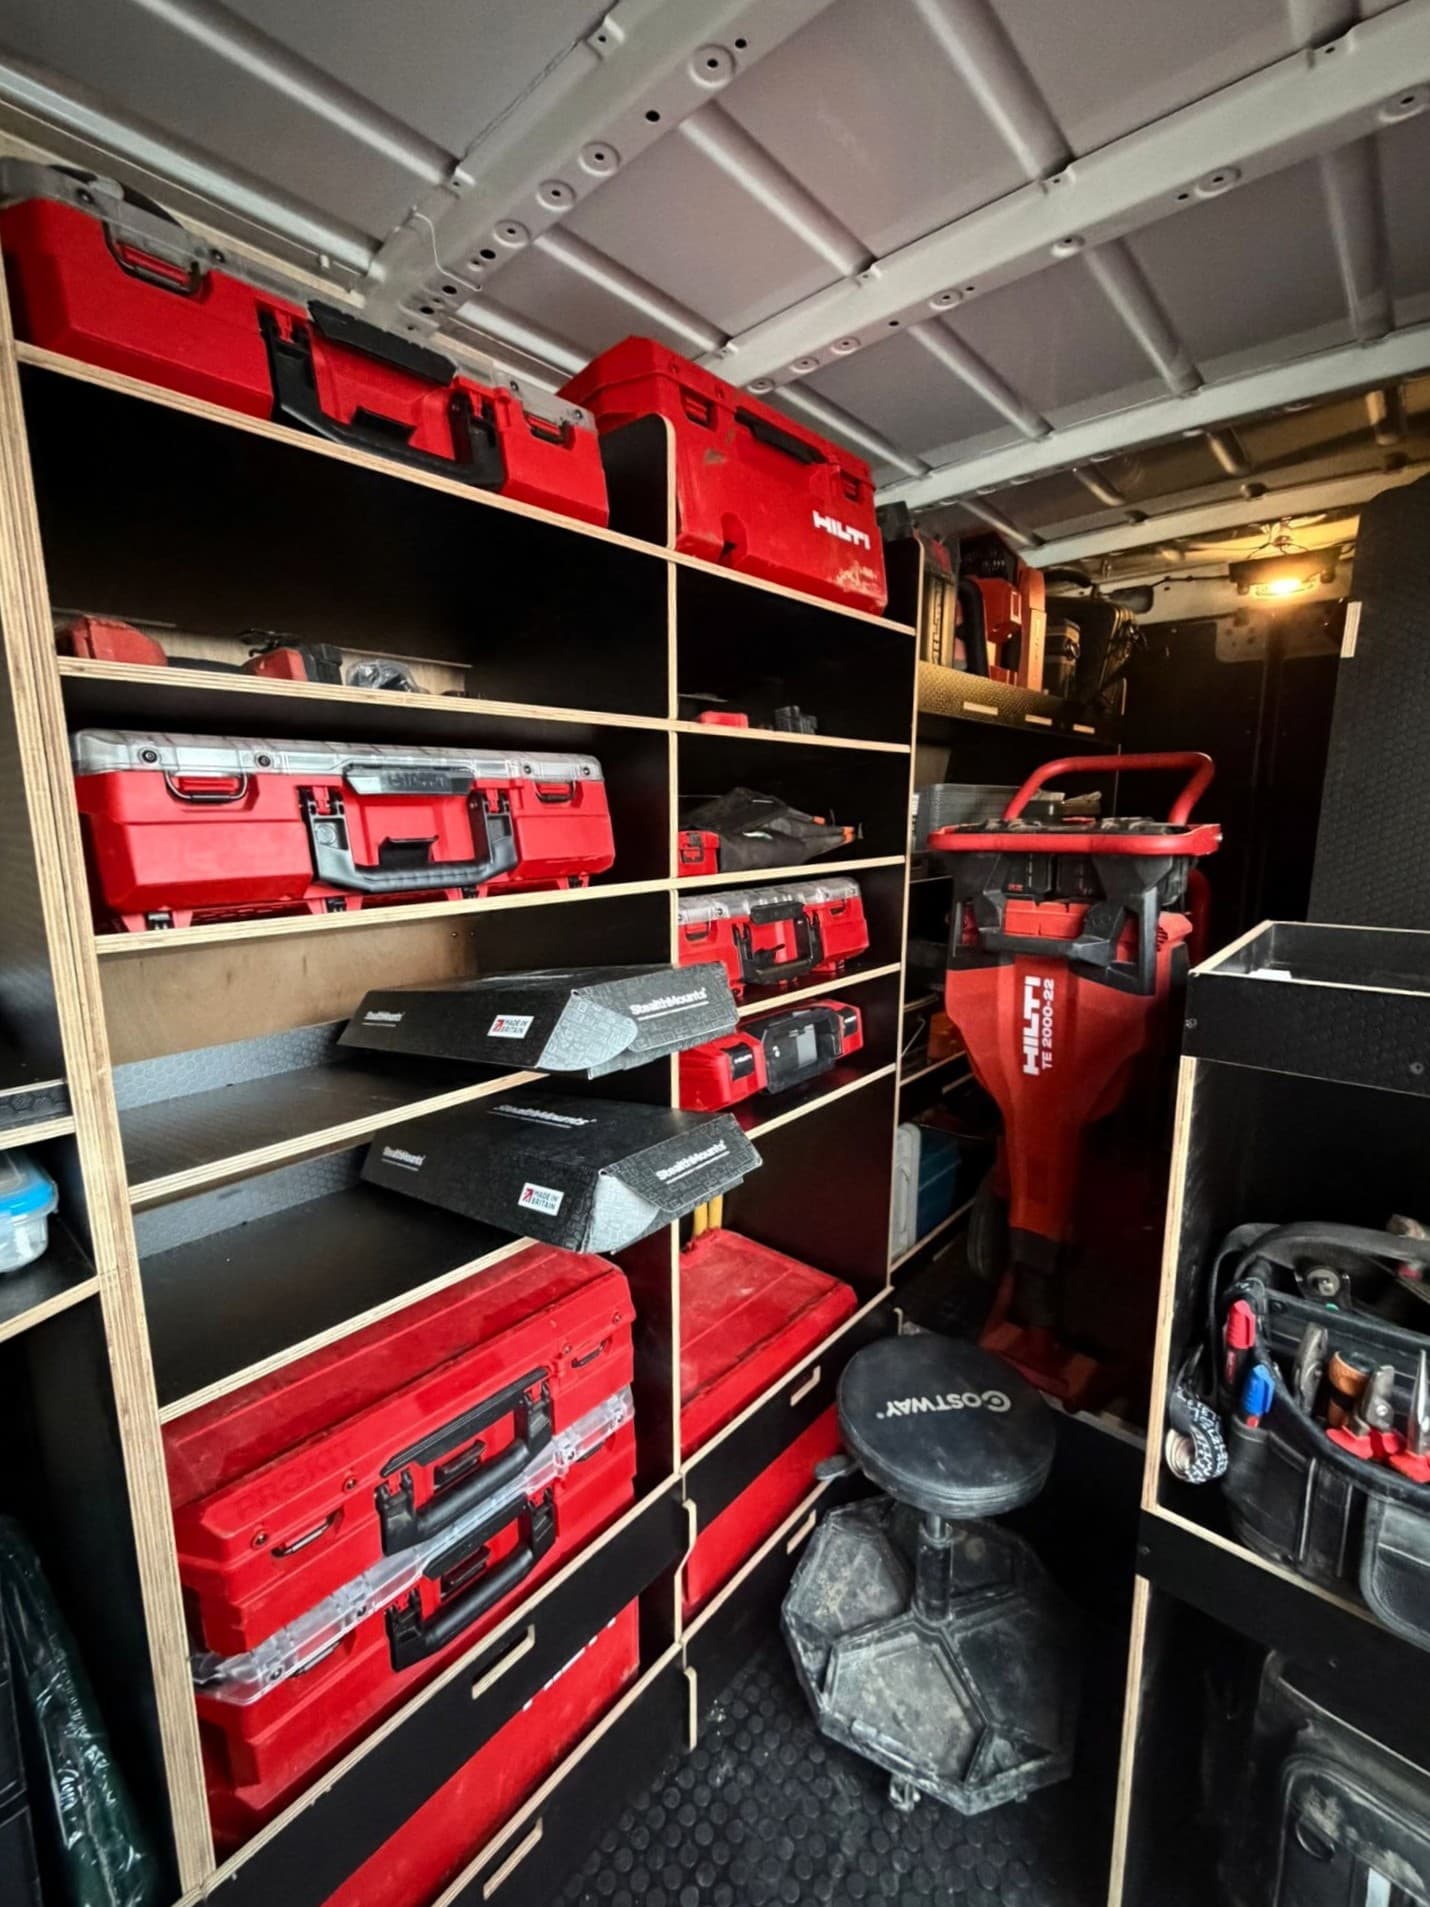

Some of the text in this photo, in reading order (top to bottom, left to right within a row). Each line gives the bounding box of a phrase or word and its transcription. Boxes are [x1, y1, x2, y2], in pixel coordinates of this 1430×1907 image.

[812, 509, 871, 551] HILTI
[629, 987, 708, 1016] StealthMounts
[1022, 975, 1041, 1077] HILTI
[1041, 978, 1055, 1071] TE 2000-22
[656, 1139, 728, 1181] StealthMounts
